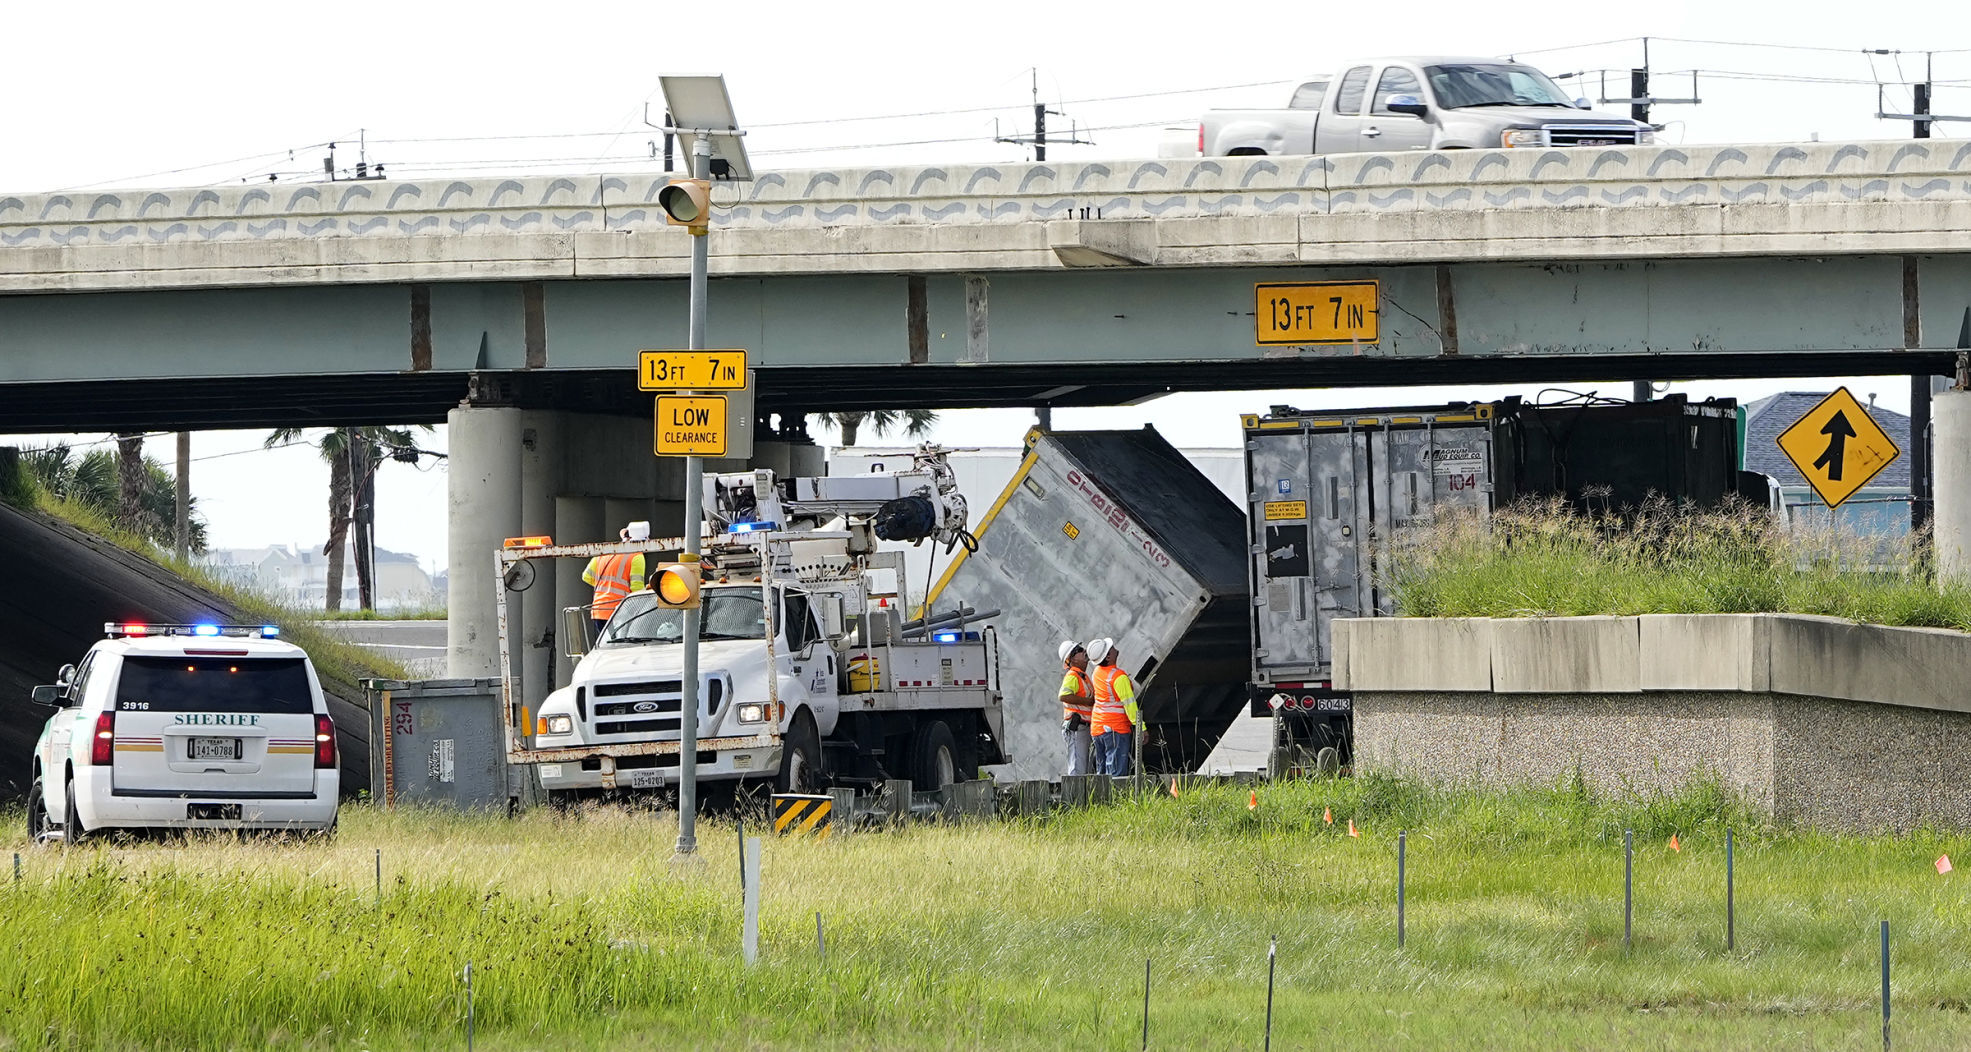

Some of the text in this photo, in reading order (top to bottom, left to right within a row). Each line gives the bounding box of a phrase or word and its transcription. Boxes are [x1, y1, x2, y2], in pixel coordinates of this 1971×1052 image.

[1270, 296, 1363, 331] 13 FT 7 IN
[650, 359, 735, 381] 13 FT 7 IN
[673, 408, 709, 426] LOW
[664, 431, 718, 443] CLEARANCE
[1449, 473, 1475, 491] 104
[122, 701, 150, 710] 3916
[1318, 699, 1349, 710] 6043
[174, 714, 260, 726] SHERIFF
[395, 702, 413, 736] 294
[383, 715, 392, 745] LIFTING
